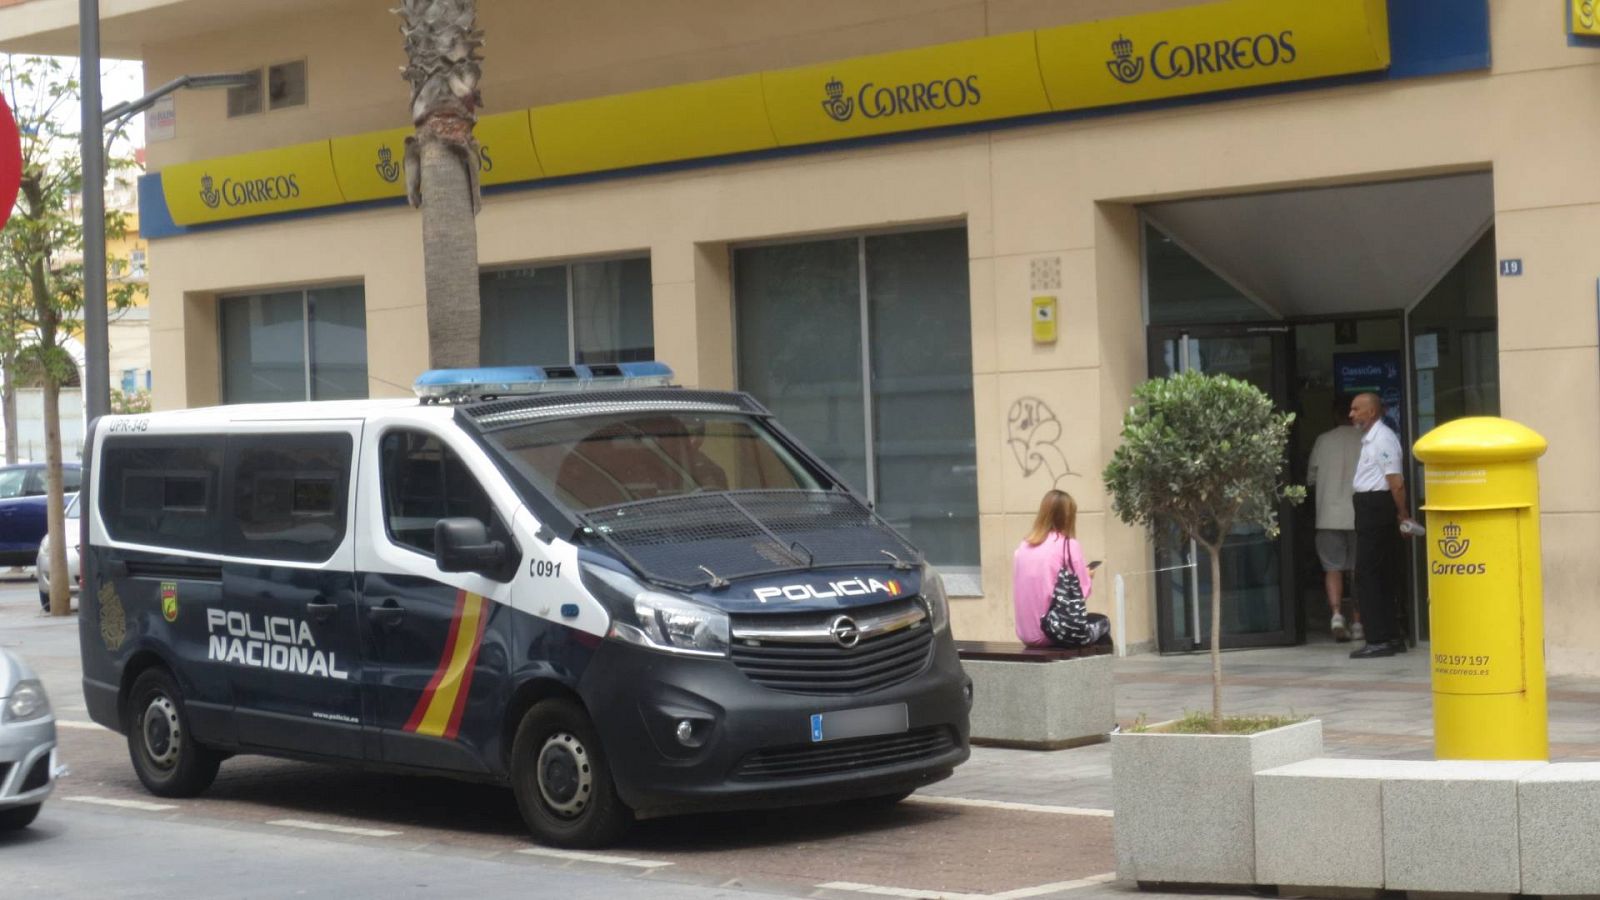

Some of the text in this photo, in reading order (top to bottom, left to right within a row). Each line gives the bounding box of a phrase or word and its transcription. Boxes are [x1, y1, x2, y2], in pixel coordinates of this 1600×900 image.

[1150, 30, 1297, 79] CORREOS
[858, 75, 981, 119] CORREOS
[222, 174, 300, 207] CORREOS
[1503, 261, 1519, 274] 19
[536, 560, 562, 578] 091
[1431, 560, 1487, 575] Correos
[206, 607, 316, 647] POLICIA
[207, 635, 349, 680] NACIONAL
[1449, 655, 1467, 666] 197
[1469, 655, 1490, 666] 197
